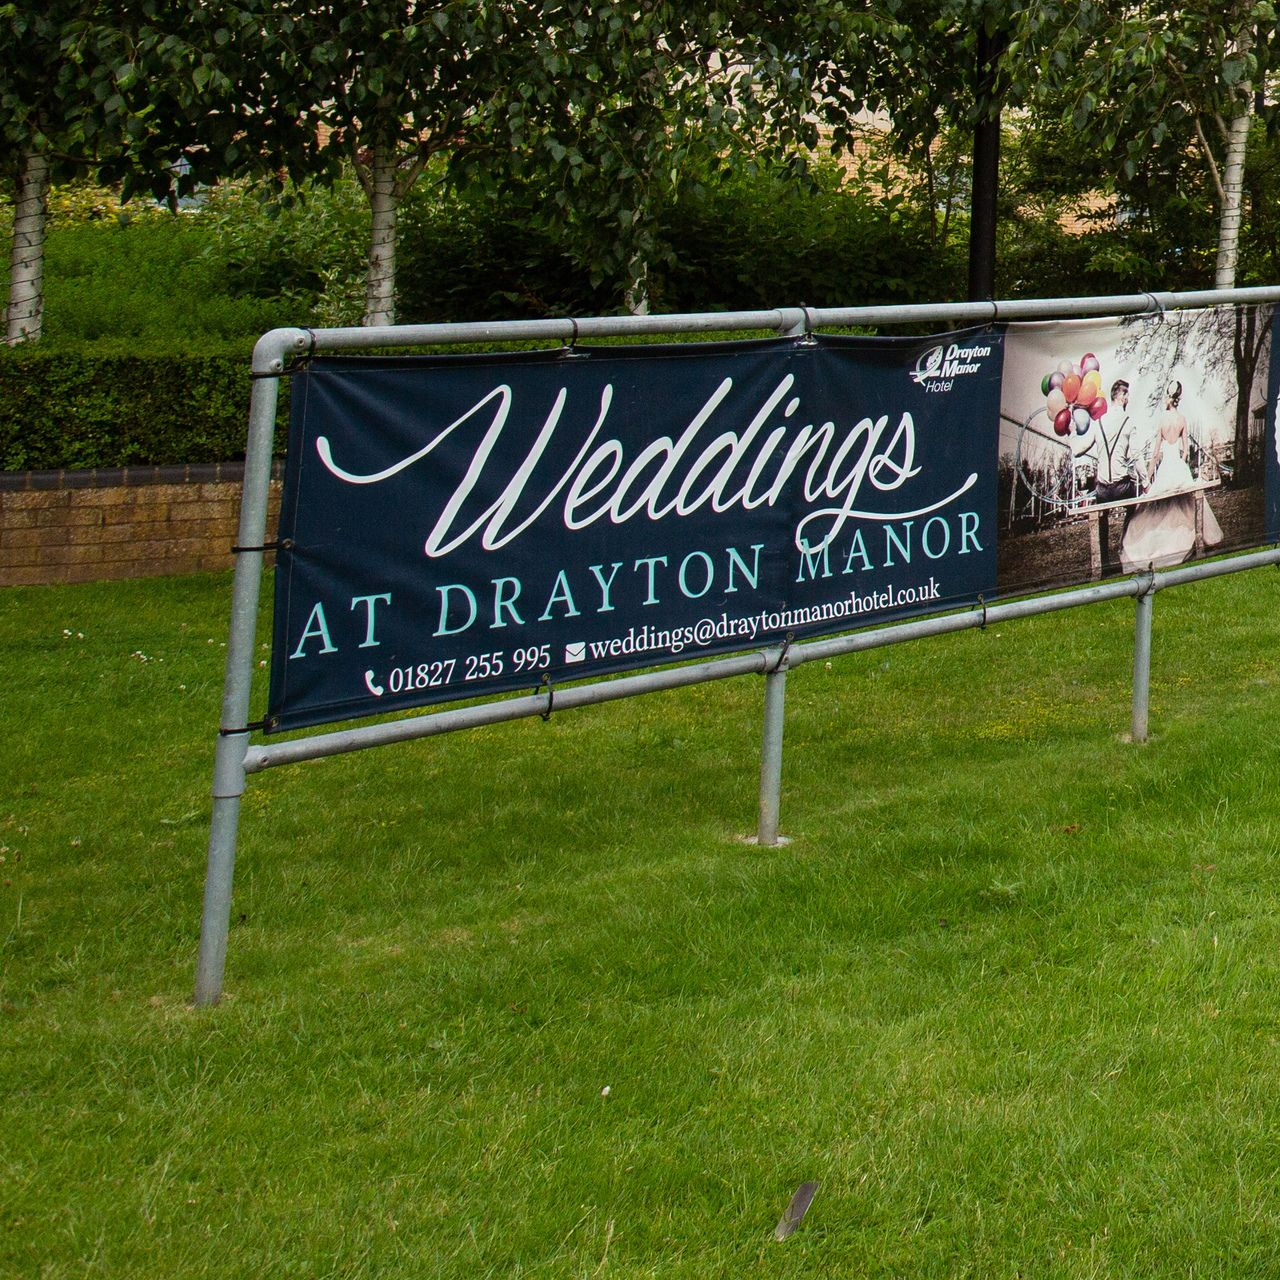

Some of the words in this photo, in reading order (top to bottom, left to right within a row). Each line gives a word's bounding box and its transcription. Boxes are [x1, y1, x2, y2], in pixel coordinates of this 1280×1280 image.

[925, 379, 954, 393] Hotel
[940, 360, 981, 378] Manor
[945, 343, 991, 363] Drayton
[316, 372, 979, 558] Weddings
[289, 592, 392, 660] AT
[432, 543, 764, 637] DRAYTON
[795, 511, 984, 583] MANOR
[389, 658, 457, 693] 01827
[464, 651, 504, 681] 255
[512, 644, 551, 673] 995
[588, 576, 941, 659] weddings@draytonmanorhotel.co.uk
